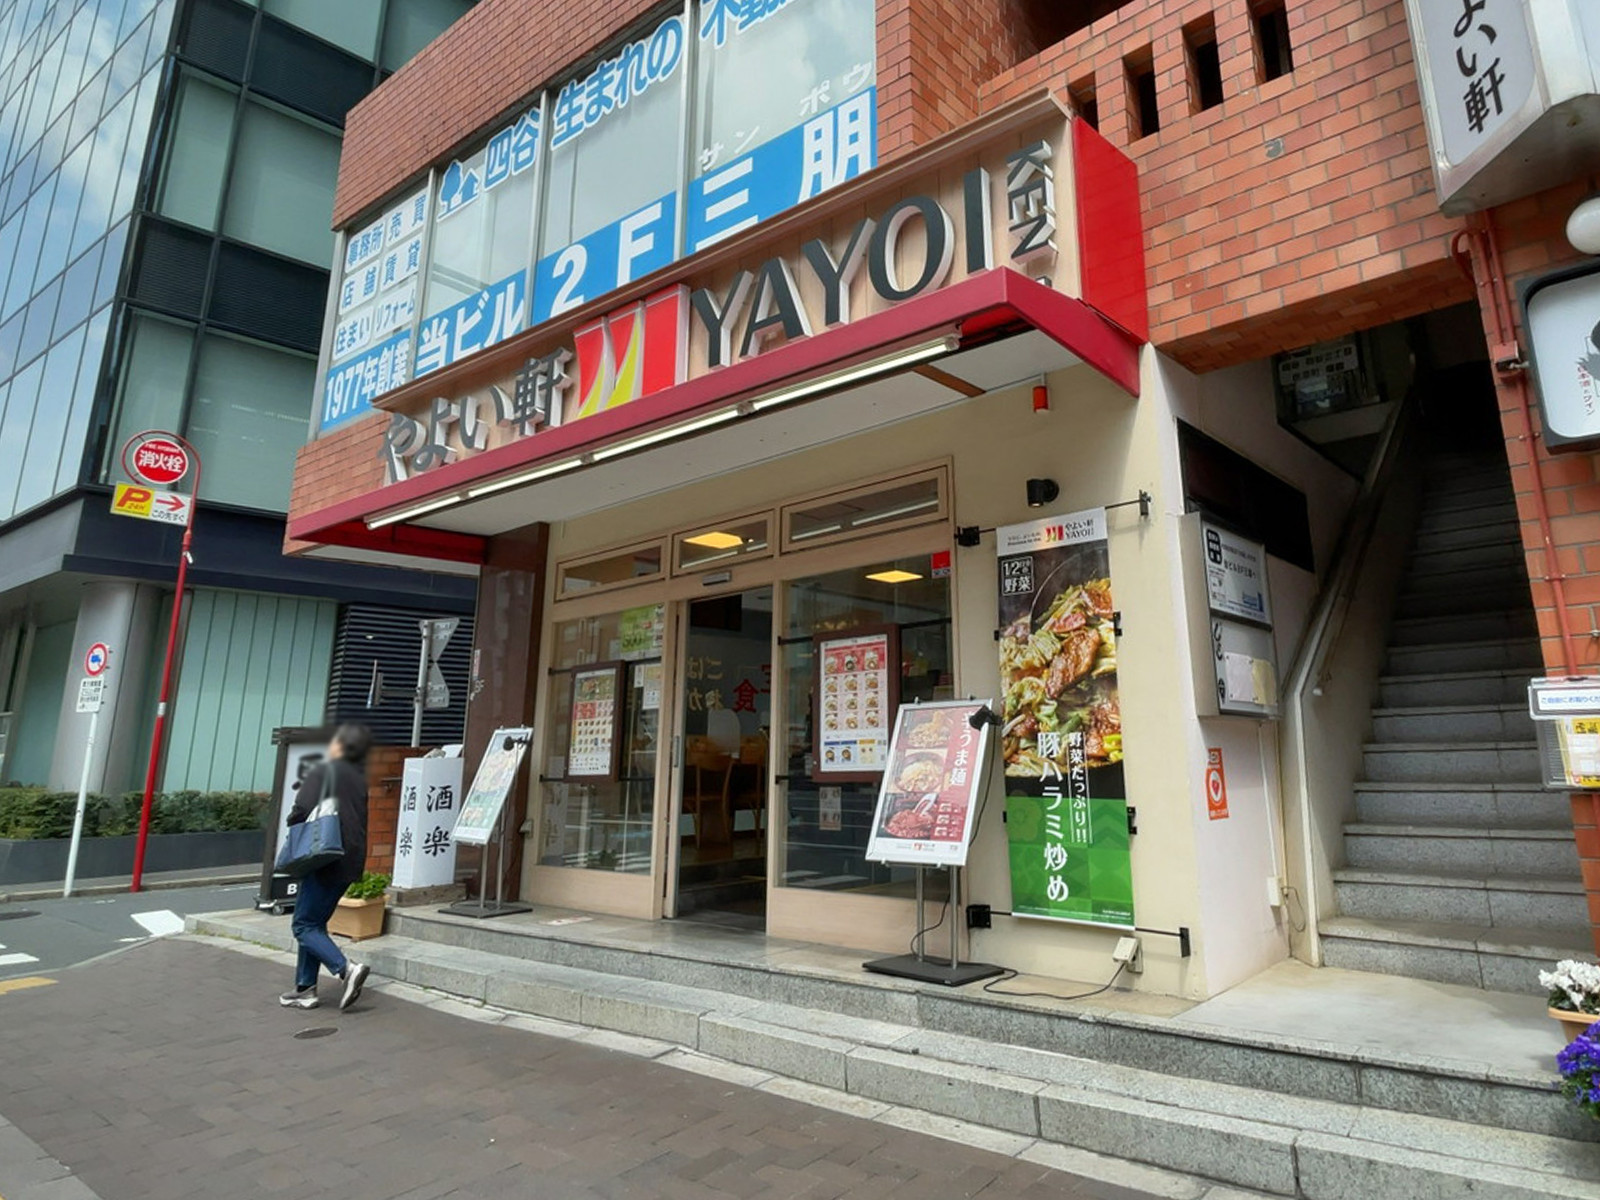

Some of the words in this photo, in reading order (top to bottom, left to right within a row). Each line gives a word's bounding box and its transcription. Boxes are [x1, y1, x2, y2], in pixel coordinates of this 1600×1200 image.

[484, 107, 541, 191] 四谷
[551, 18, 683, 150] 生まれの
[335, 318, 371, 357] 住まい
[376, 289, 415, 333] リフォーム
[343, 266, 378, 307] 店舗
[380, 346, 574, 485] やよい軒
[690, 166, 994, 371] YAYOI
[1005, 139, 1058, 264] KEN
[414, 280, 525, 379] 当ビル
[324, 339, 410, 423] 1977年創業
[117, 487, 152, 508] P
[139, 450, 183, 473] 消火栓
[1004, 575, 1032, 593] 野菜
[399, 786, 416, 859] 酒楽
[421, 784, 453, 858] 酒楽
[1037, 731, 1069, 902] 豚ハラミ炒め
